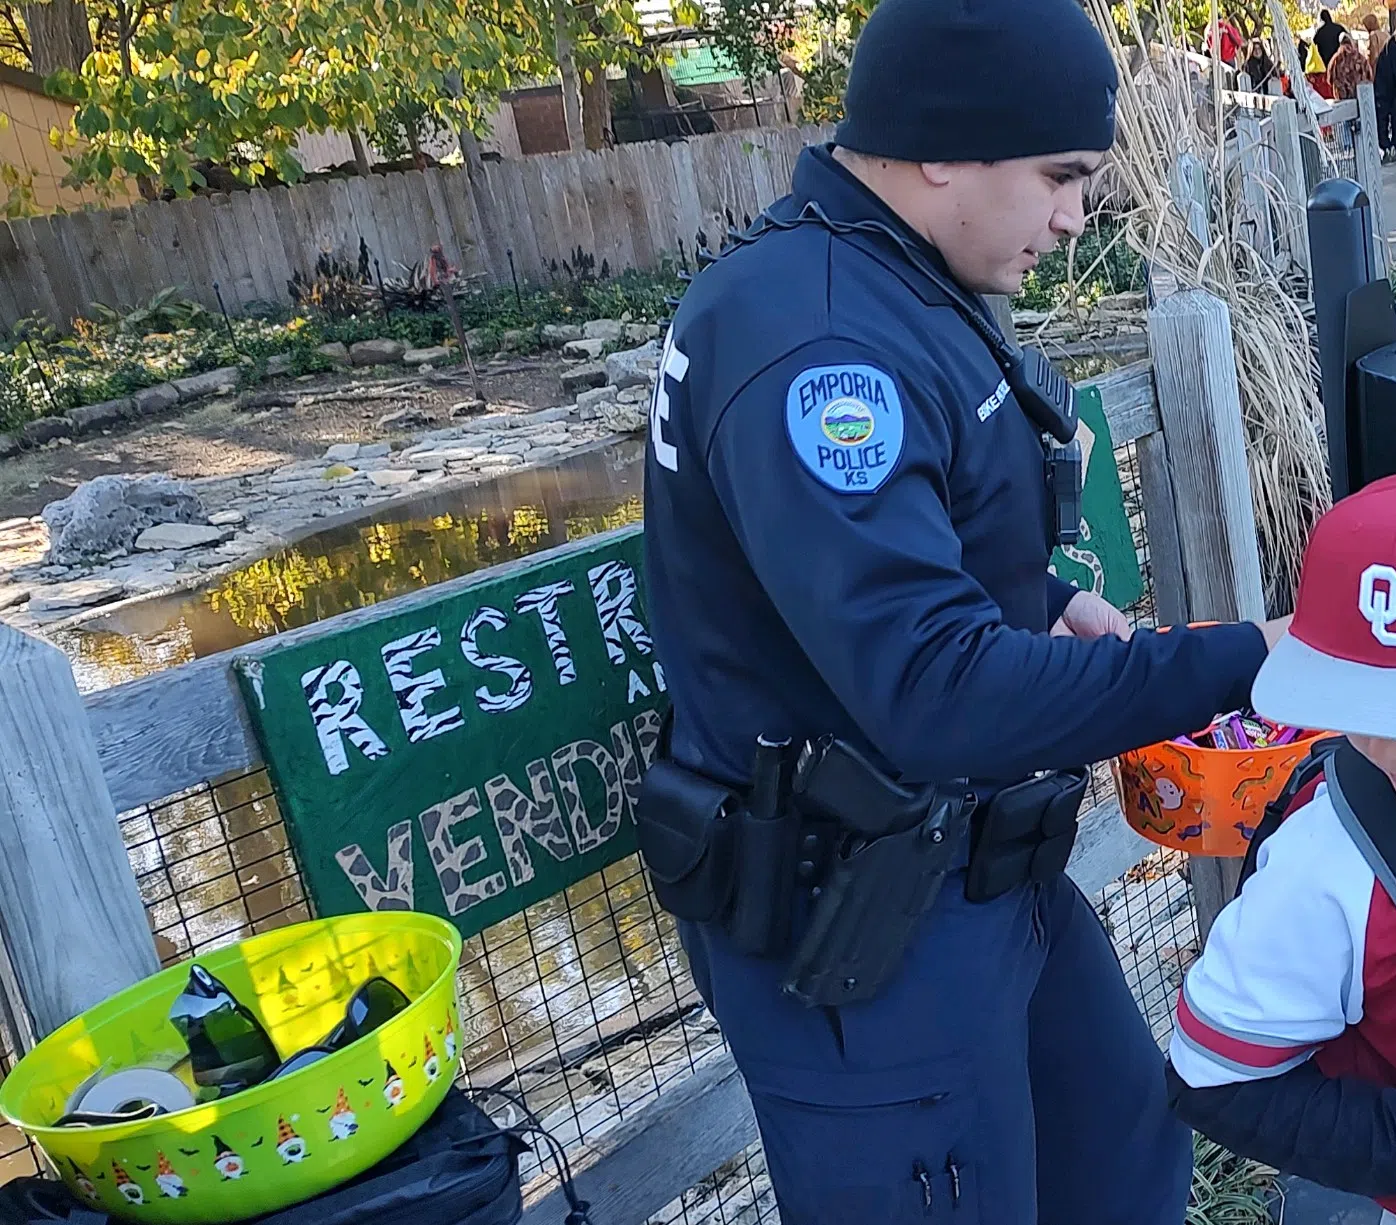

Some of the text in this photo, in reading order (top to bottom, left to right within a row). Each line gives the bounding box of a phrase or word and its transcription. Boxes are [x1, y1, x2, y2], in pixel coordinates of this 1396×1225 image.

[799, 371, 889, 419] EMPORIA
[817, 441, 887, 470] POLICE
[844, 471, 868, 486] KS
[301, 560, 654, 775] RESTR
[335, 709, 664, 916] VENDI
